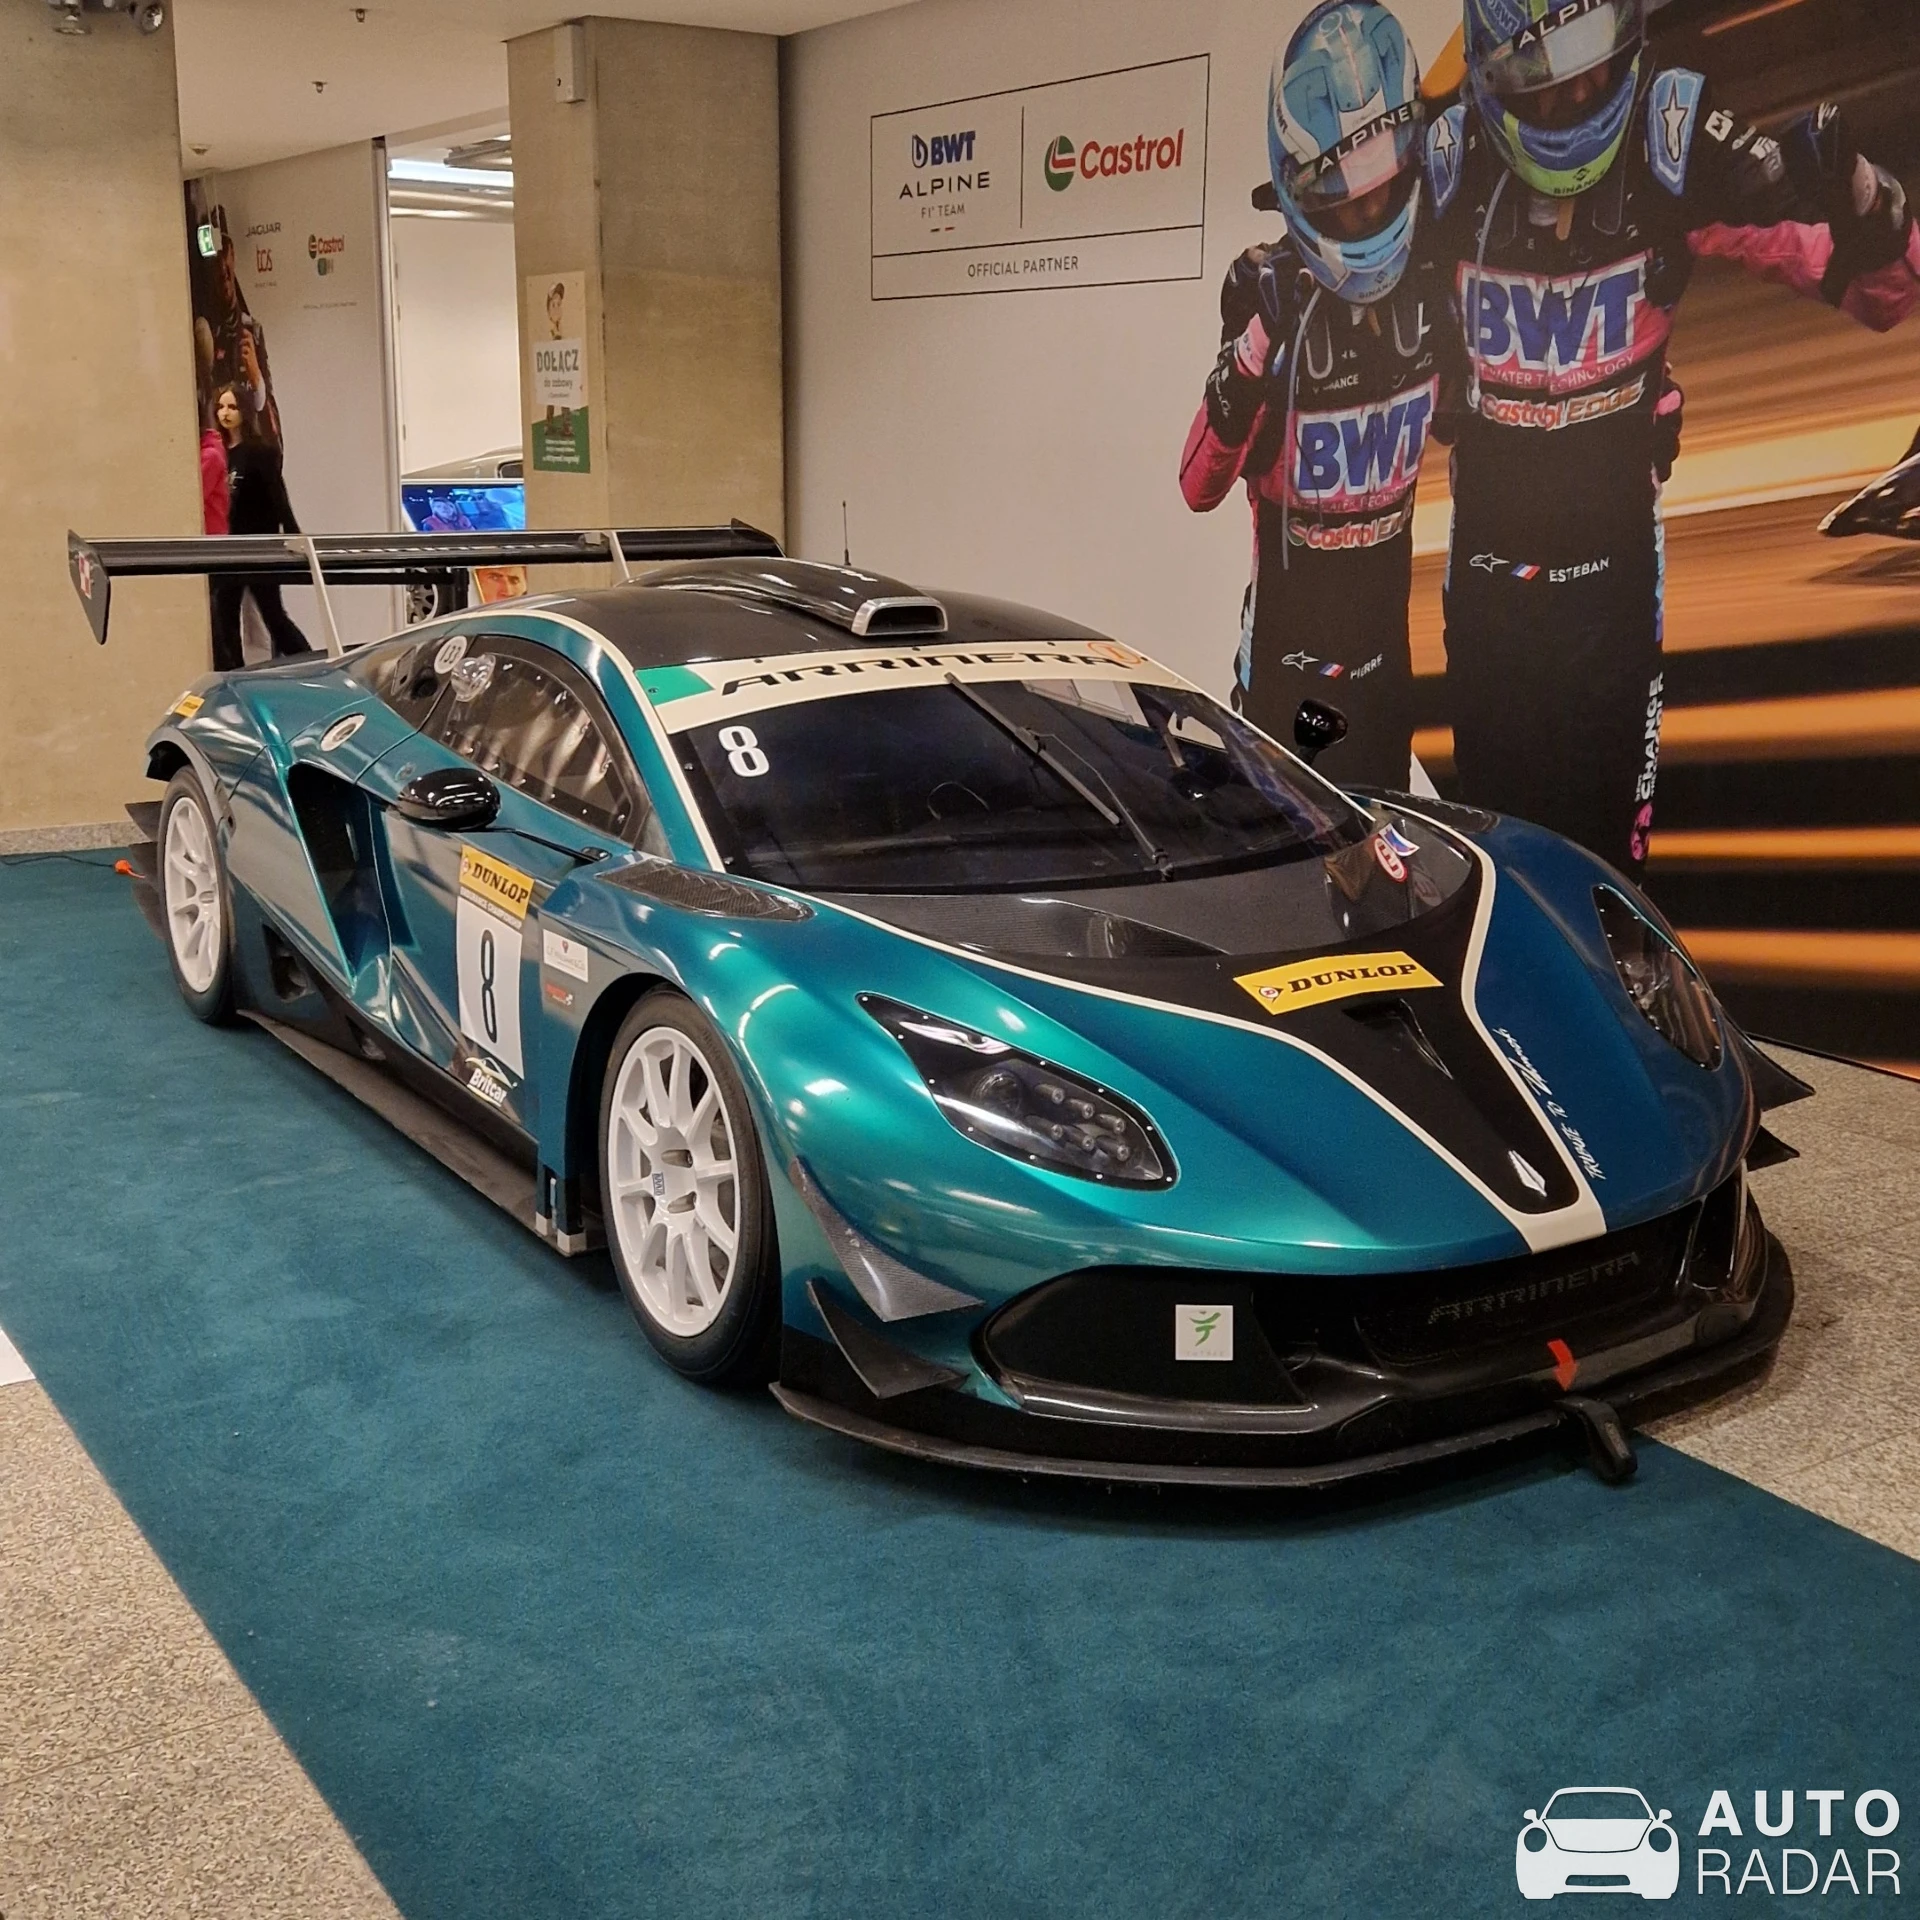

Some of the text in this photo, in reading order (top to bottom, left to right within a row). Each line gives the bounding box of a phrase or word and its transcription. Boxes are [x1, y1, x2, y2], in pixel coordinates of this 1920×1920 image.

[1518, 0, 1600, 49] ALPI
[930, 131, 977, 166] BWT
[1080, 128, 1184, 180] Castrol
[1319, 104, 1412, 176] ALPINE
[899, 171, 991, 200] ALPINE
[938, 204, 965, 217] TEAM
[245, 222, 281, 238] JAGUAR
[317, 235, 345, 255] Castrol
[968, 256, 1079, 277] OFFICIAL PARTNER
[1466, 268, 1640, 367] BWT
[536, 349, 579, 374] DOŁĄCZ
[1481, 393, 1564, 430] Castrol
[1298, 391, 1431, 491] BWT
[1306, 521, 1378, 550] Castrol
[1549, 557, 1610, 583] ESTEBAN
[722, 653, 1136, 696] ARRINERA
[1350, 654, 1383, 679] PIERRE
[718, 725, 769, 777] 8
[1640, 676, 1660, 800] CHANGE
[471, 862, 529, 904] DUNLOP
[480, 929, 498, 1044] 8
[1287, 964, 1417, 993] DUNLOP
[469, 1067, 508, 1103] Britcar
[1427, 1251, 1641, 1325] ARRINERA
